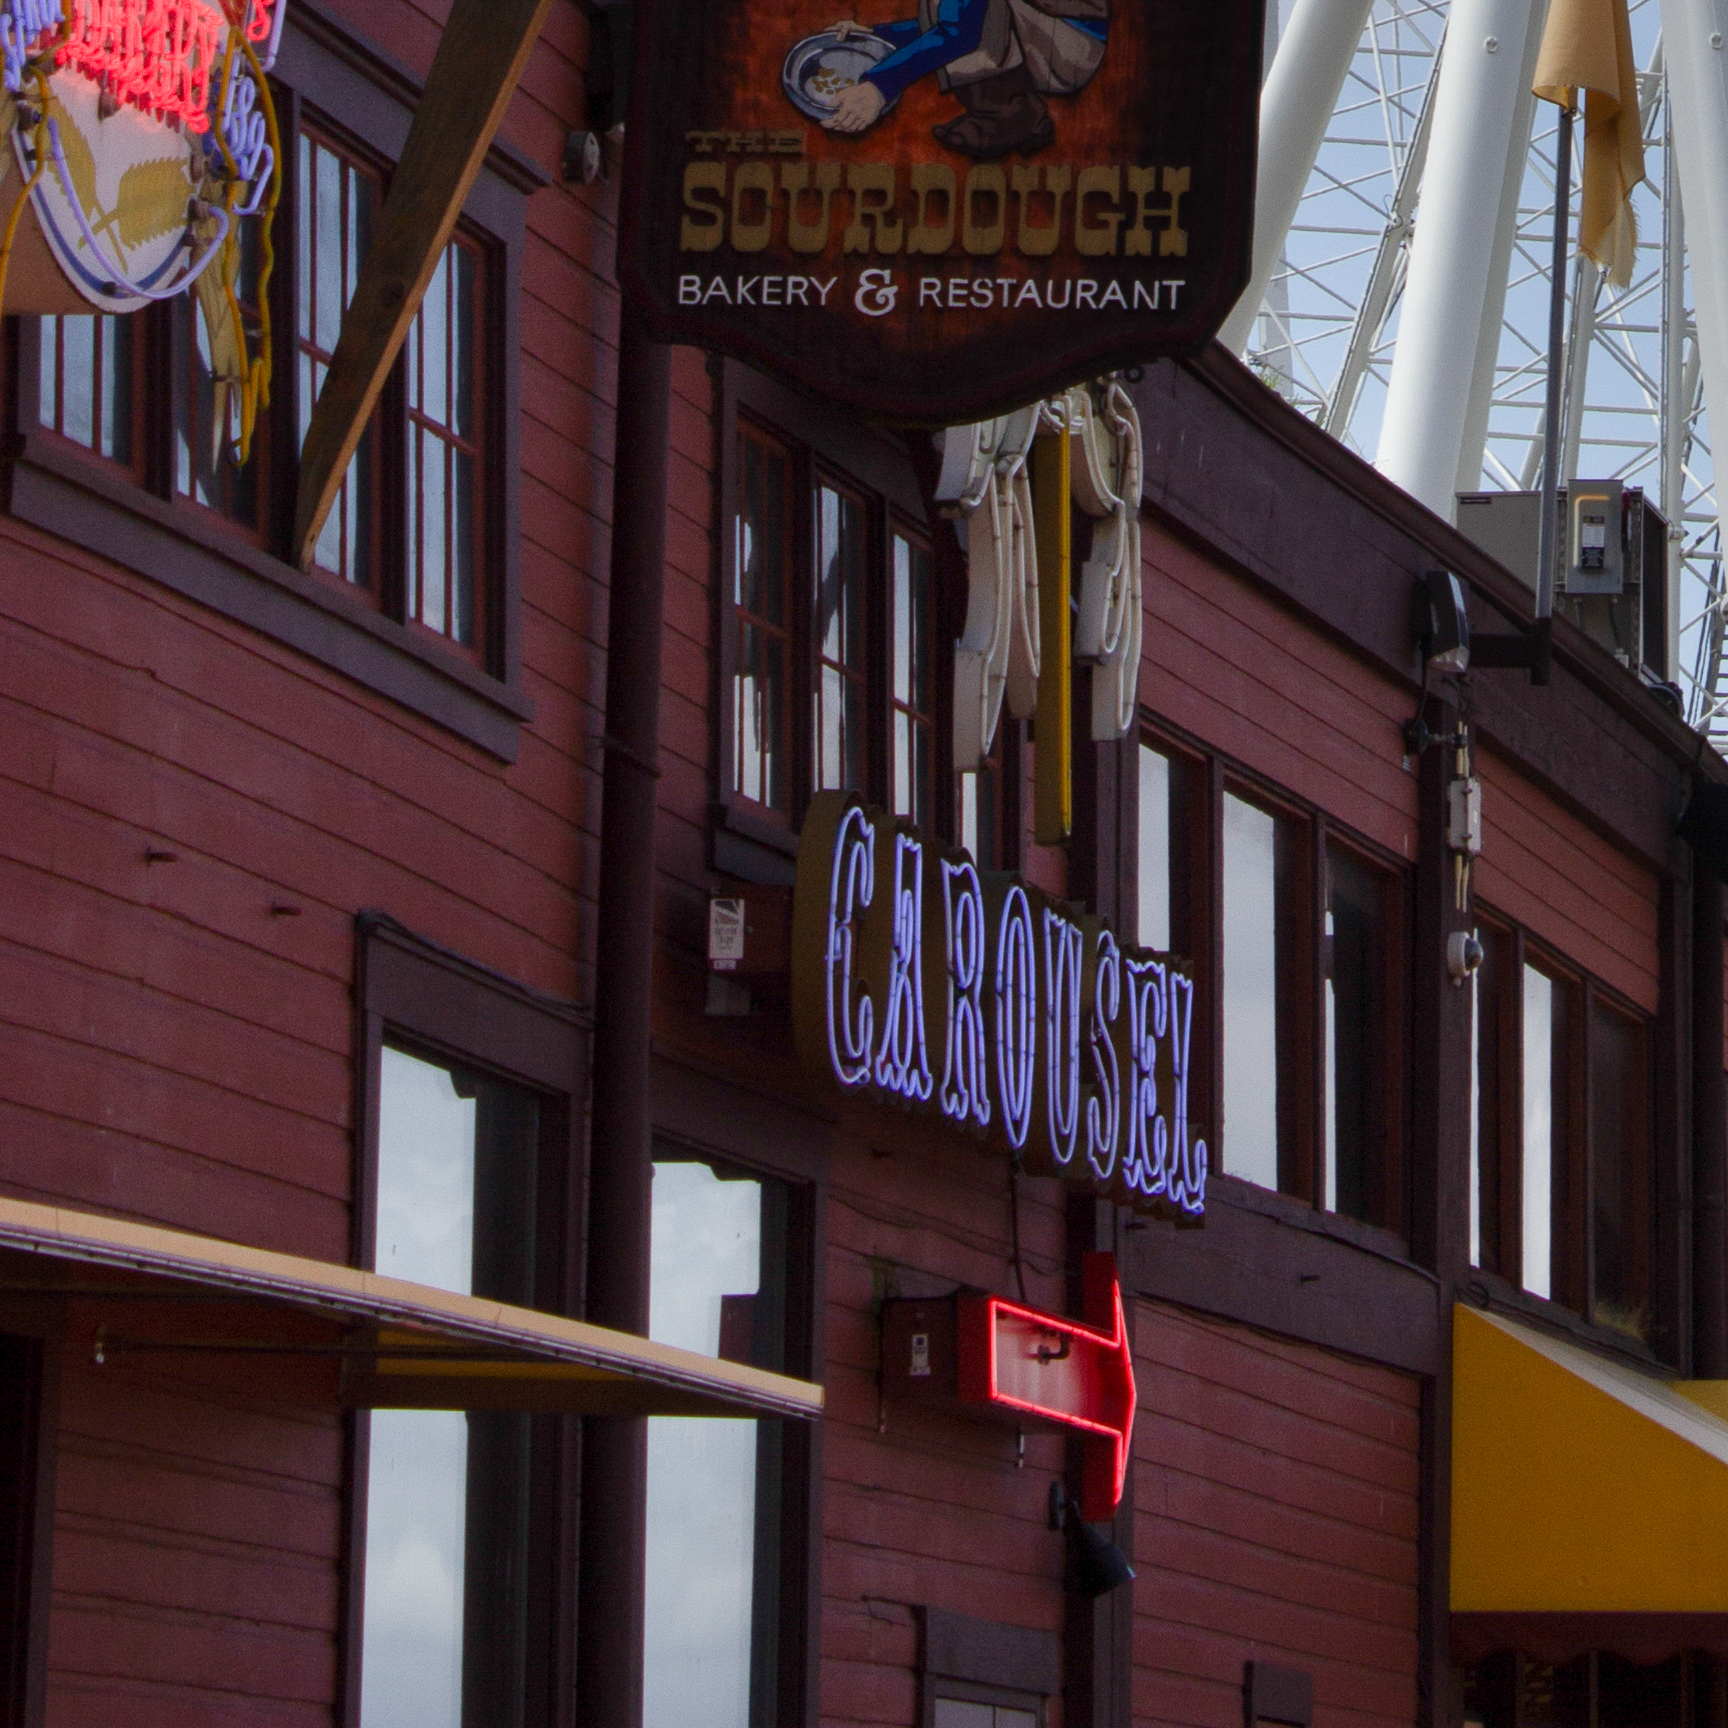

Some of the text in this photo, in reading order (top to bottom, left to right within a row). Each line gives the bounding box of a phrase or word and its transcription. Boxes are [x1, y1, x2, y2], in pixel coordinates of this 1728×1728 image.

[684, 131, 809, 155] THE
[680, 161, 1192, 257] SOURDOUGH
[678, 268, 1187, 316] BAKERY & RESTAURANT
[826, 804, 1208, 1215] CAROUSEL
